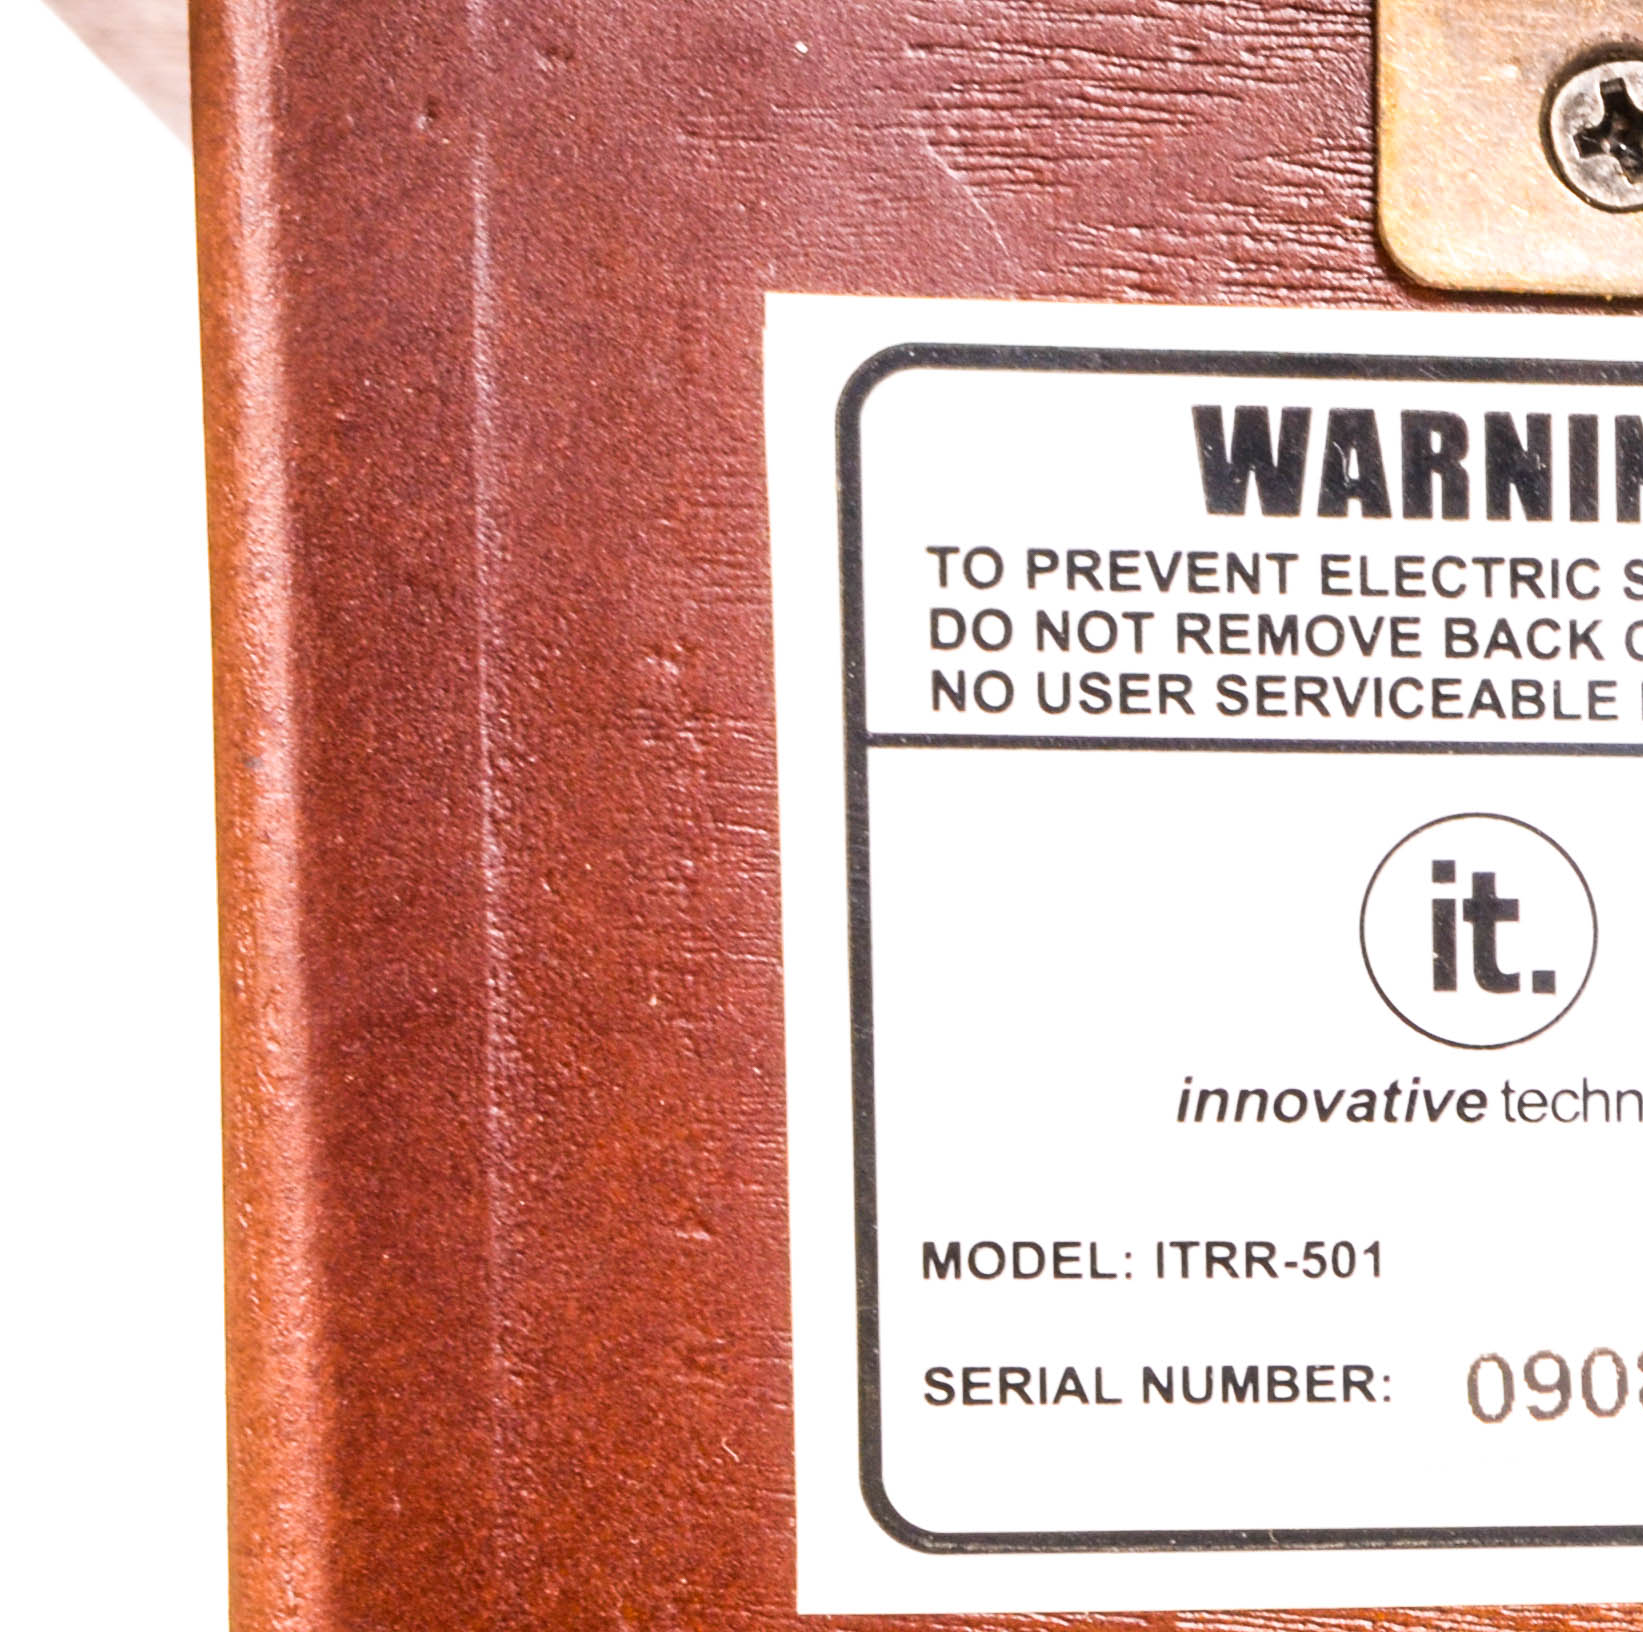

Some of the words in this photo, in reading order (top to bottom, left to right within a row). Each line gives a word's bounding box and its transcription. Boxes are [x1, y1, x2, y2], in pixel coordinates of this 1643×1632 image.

[924, 544, 1006, 592] TO
[1025, 546, 1300, 596] PREVENT
[1319, 552, 1602, 602] ELECTRIC
[928, 606, 1014, 653] DO
[1035, 608, 1156, 655] NOT
[1175, 611, 1423, 660] REMOVE
[1443, 615, 1606, 662] BACK
[930, 668, 1016, 715] NO
[1036, 670, 1197, 717] USER
[1215, 672, 1620, 722] SERVICEABLE
[1175, 1074, 1489, 1125] innovative
[921, 1239, 1133, 1282] MODEL:
[1155, 1239, 1382, 1280] ITRR-501
[922, 1365, 1124, 1408] SERIAL
[1141, 1363, 1392, 1406] NUMBER:
